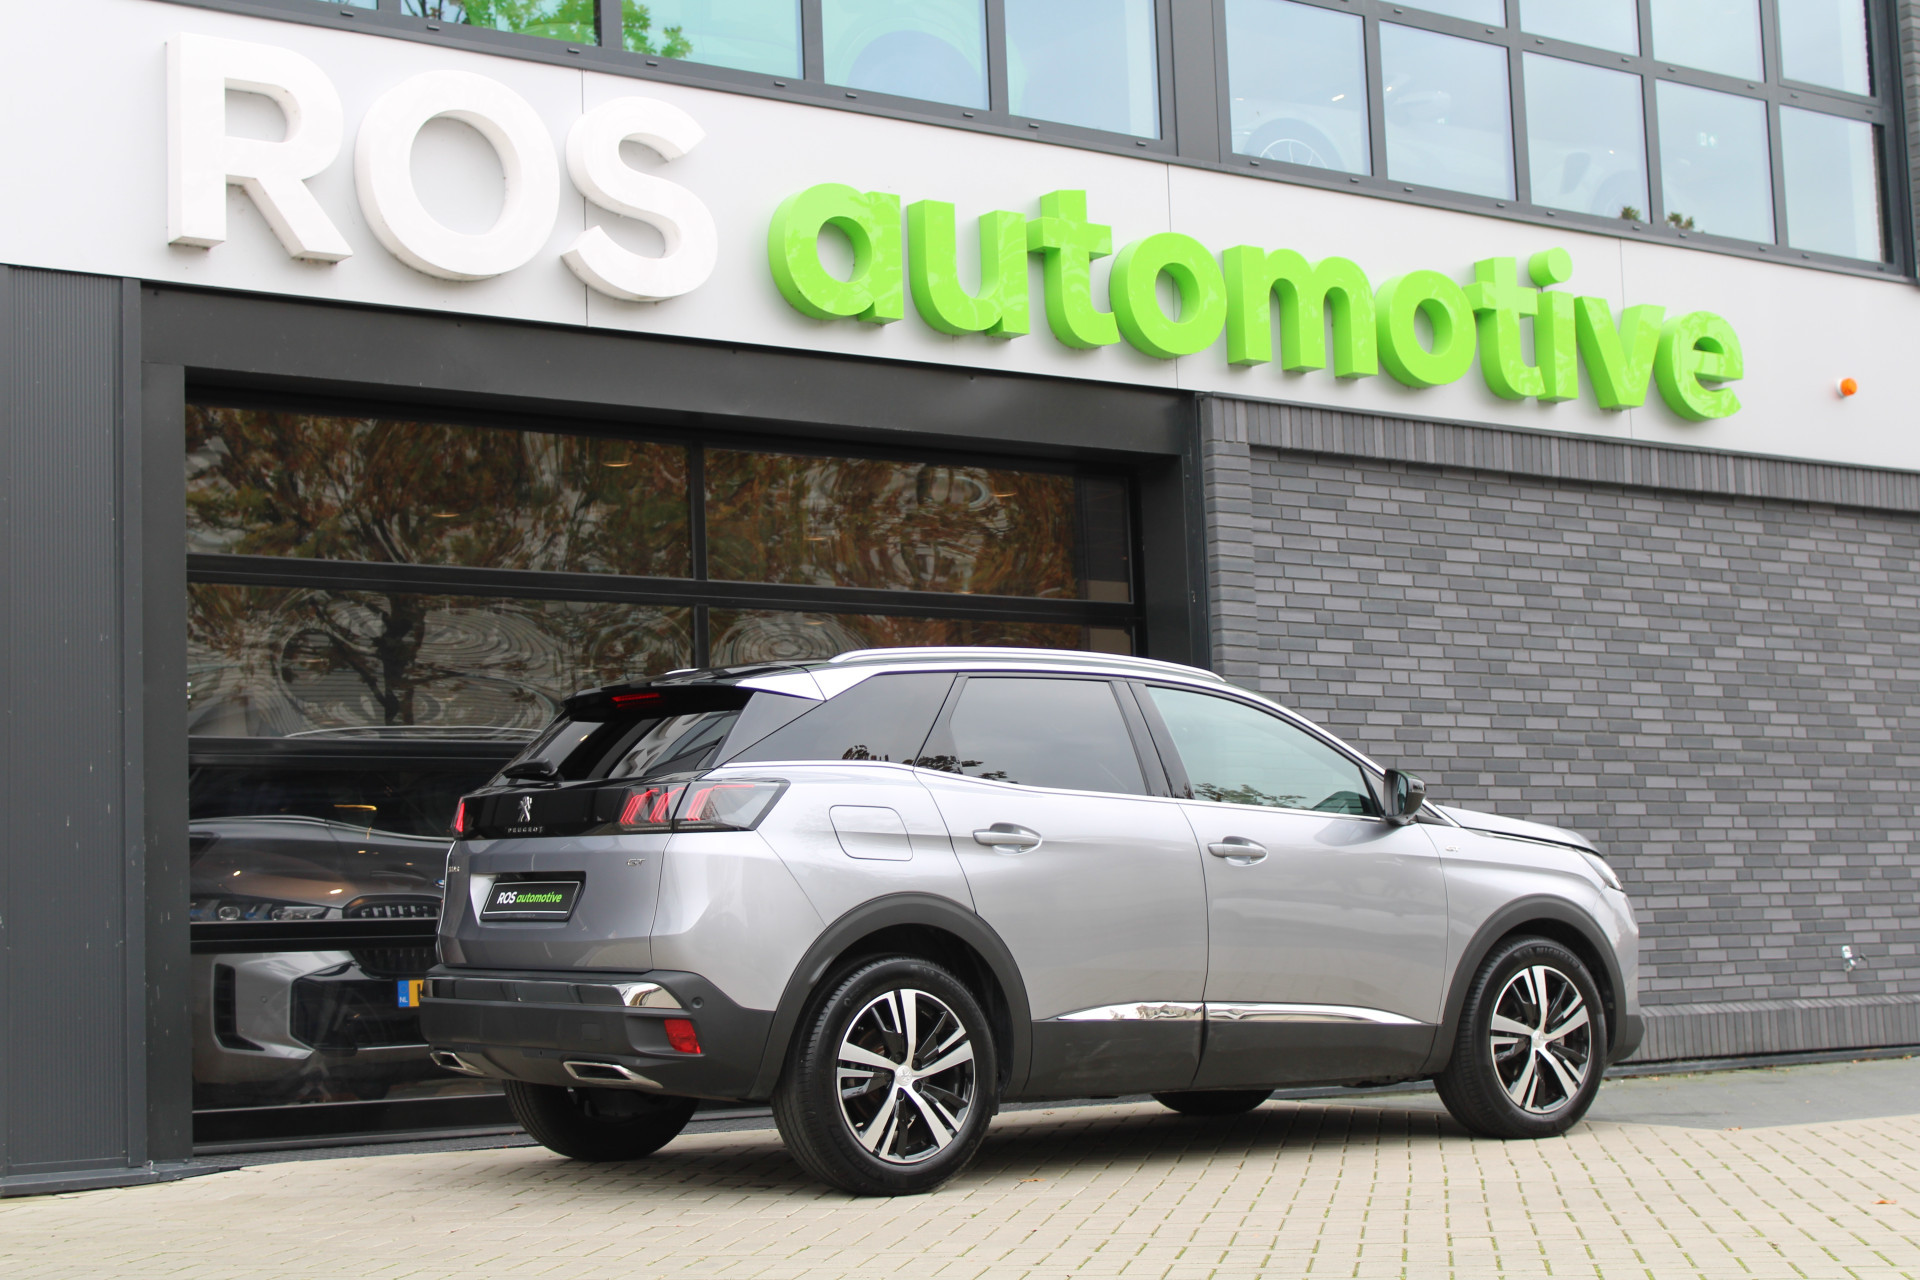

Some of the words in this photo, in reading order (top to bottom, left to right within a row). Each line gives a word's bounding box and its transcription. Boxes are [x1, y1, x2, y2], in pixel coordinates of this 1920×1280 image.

[165, 32, 718, 302] ROS
[767, 183, 1743, 422] automotive
[496, 891, 517, 904] ROS
[516, 891, 563, 903] automotive
